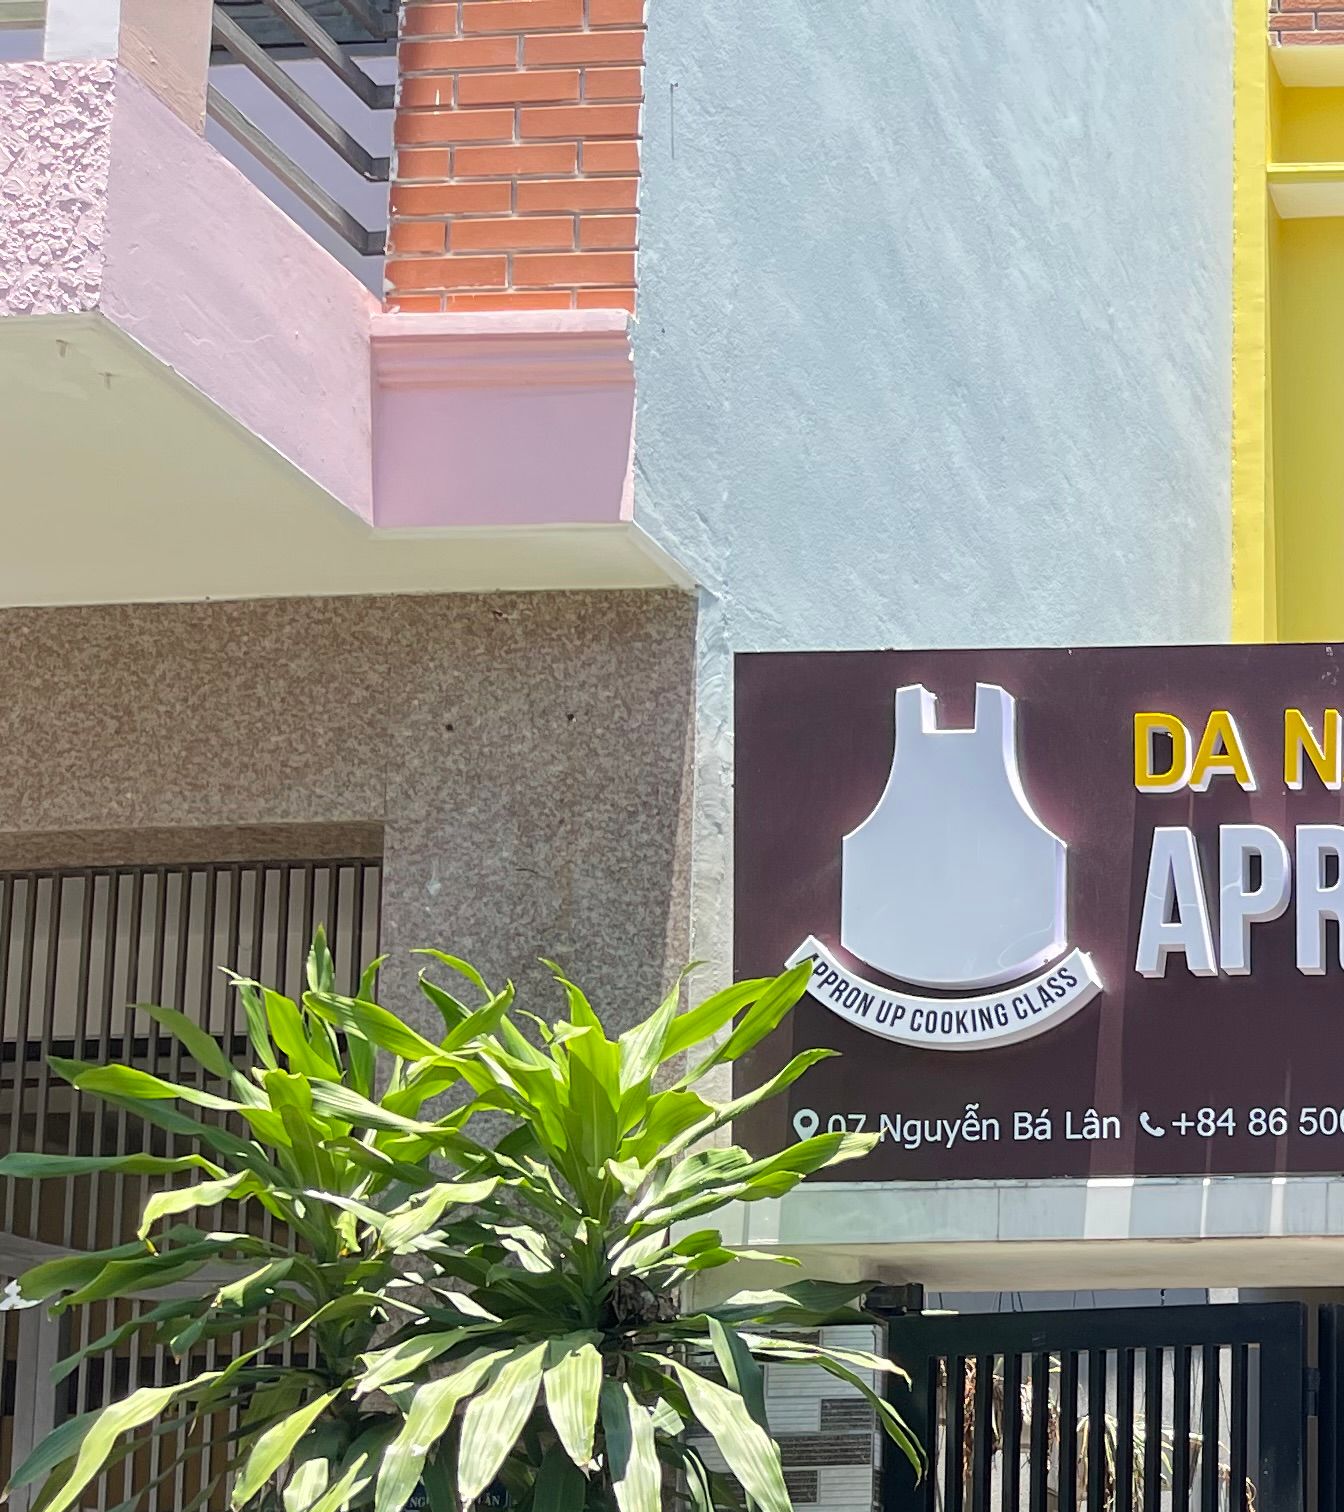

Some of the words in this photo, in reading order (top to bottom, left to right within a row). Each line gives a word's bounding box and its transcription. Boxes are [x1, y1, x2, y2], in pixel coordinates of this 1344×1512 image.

[1134, 710, 1255, 793] DA
[875, 1002, 906, 1028] UP
[910, 1002, 1009, 1034] COOKING
[1012, 966, 1079, 1020] CLASS
[828, 1114, 867, 1134] 07
[880, 1103, 1000, 1149] Nguyễn
[1013, 1109, 1051, 1141] Bá
[1065, 1108, 1121, 1140] Lân
[1171, 1107, 1237, 1137] +84
[1248, 1107, 1289, 1137] 86
